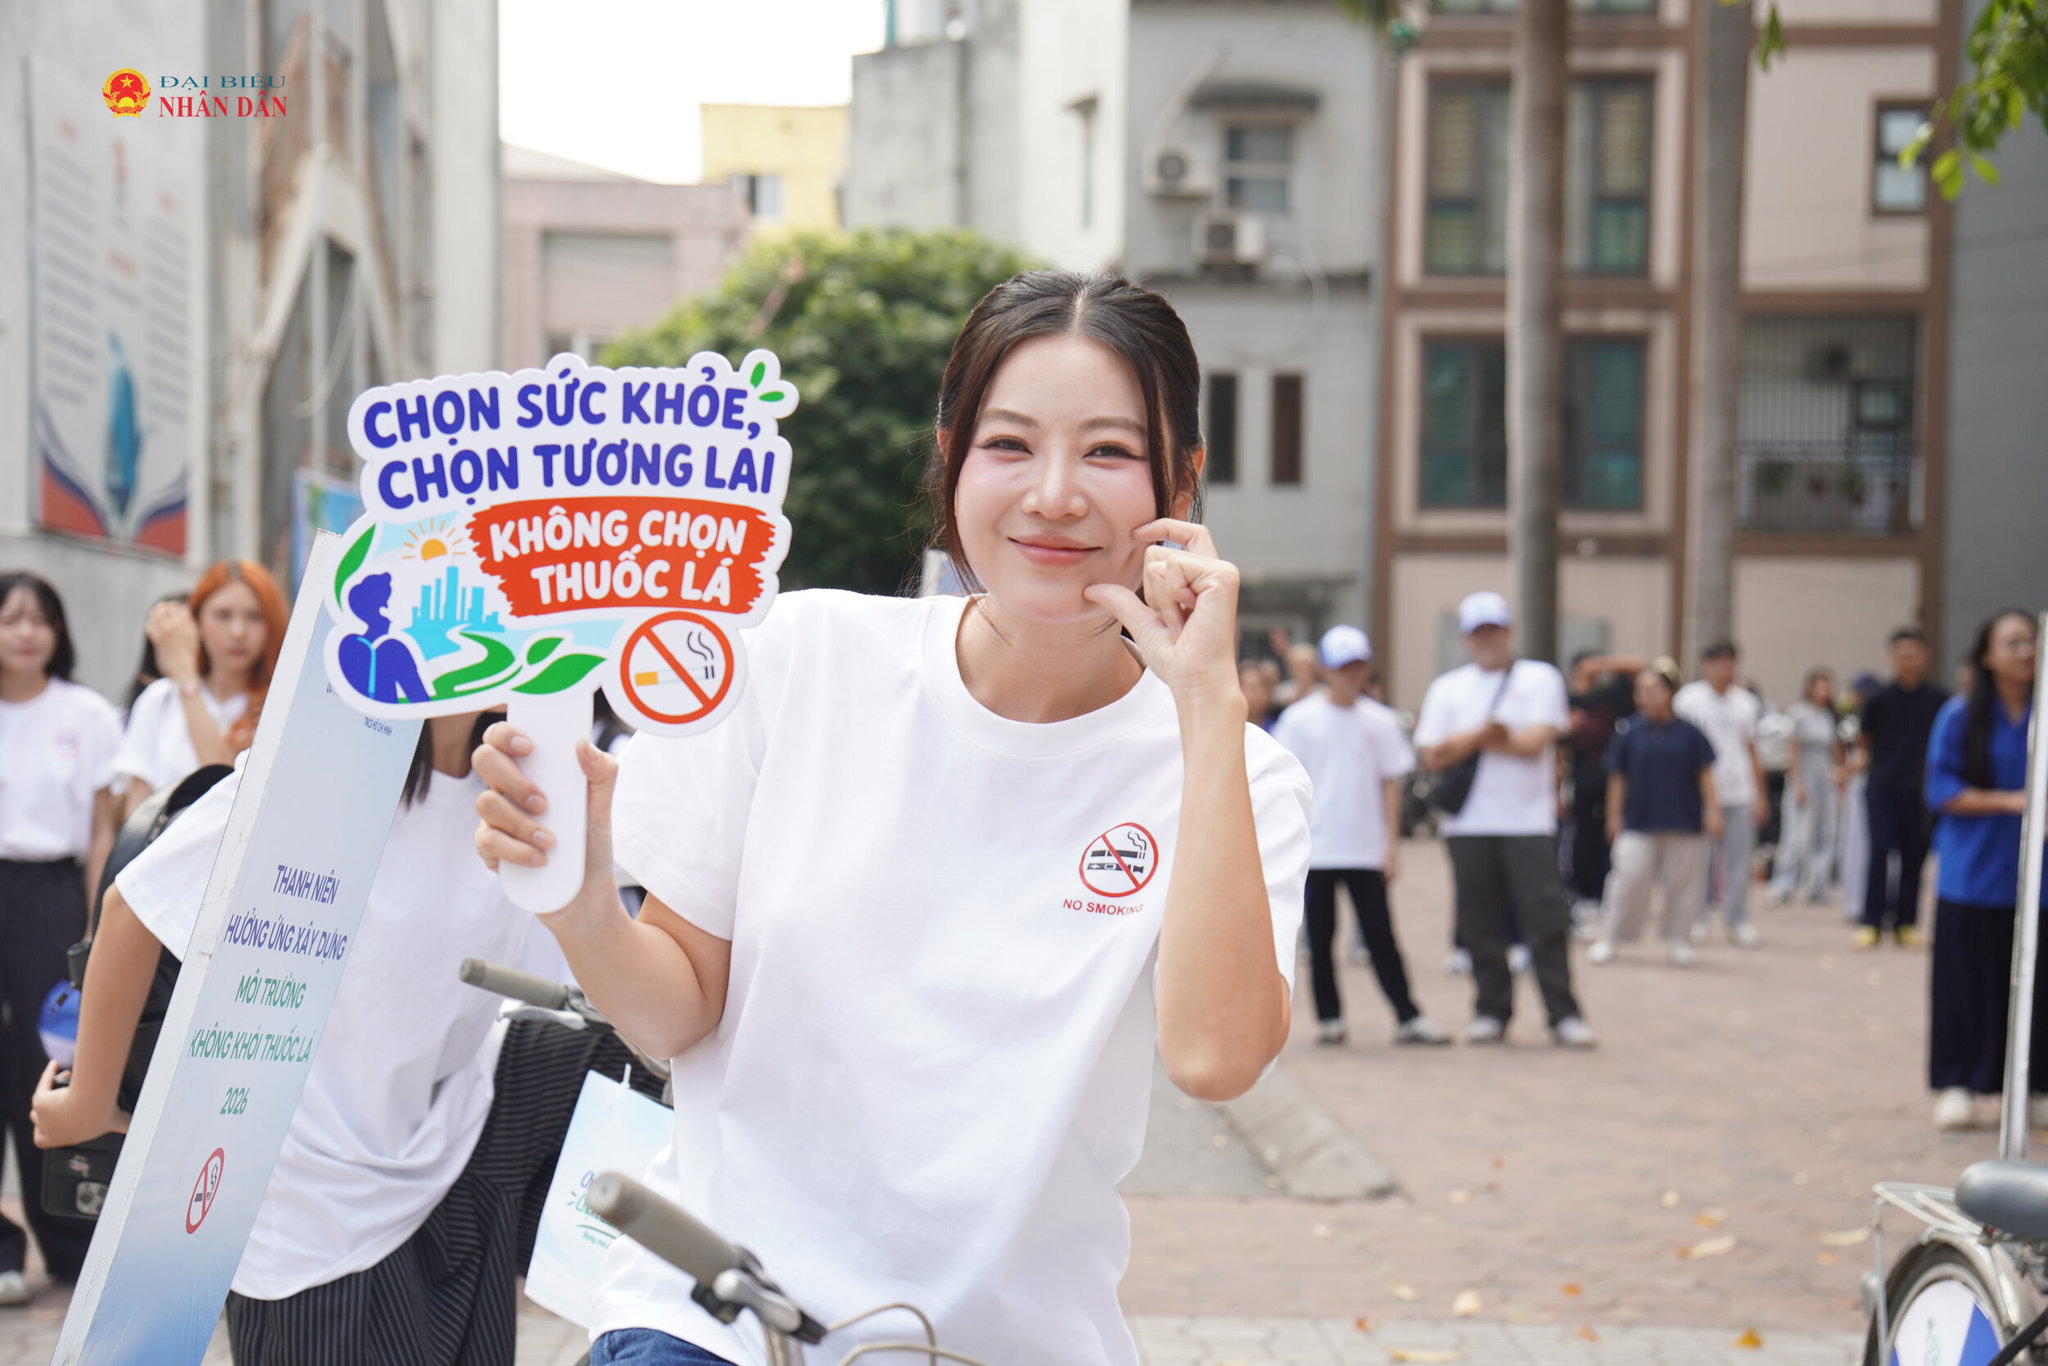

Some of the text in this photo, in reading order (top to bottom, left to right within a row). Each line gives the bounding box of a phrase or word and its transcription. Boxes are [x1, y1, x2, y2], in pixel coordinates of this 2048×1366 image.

[364, 366, 761, 448] CHỌN SỨC KHỎE,
[378, 439, 775, 510] CHỌN TƯƠNG LAI
[489, 505, 747, 562] KHÔNG CHỌN
[530, 544, 733, 606] THUỐC LÁ
[273, 864, 340, 904] THANH NIÊN
[1063, 899, 1143, 916] NO SMOKING
[224, 907, 347, 964] HƯỞNG ỨNG XÂY DỰNG
[235, 968, 307, 1009] MÔI TRƯỜNG
[188, 1021, 316, 1062] KHÔNG KHÓI THUỐC LÁ
[220, 1087, 250, 1115] 2026
